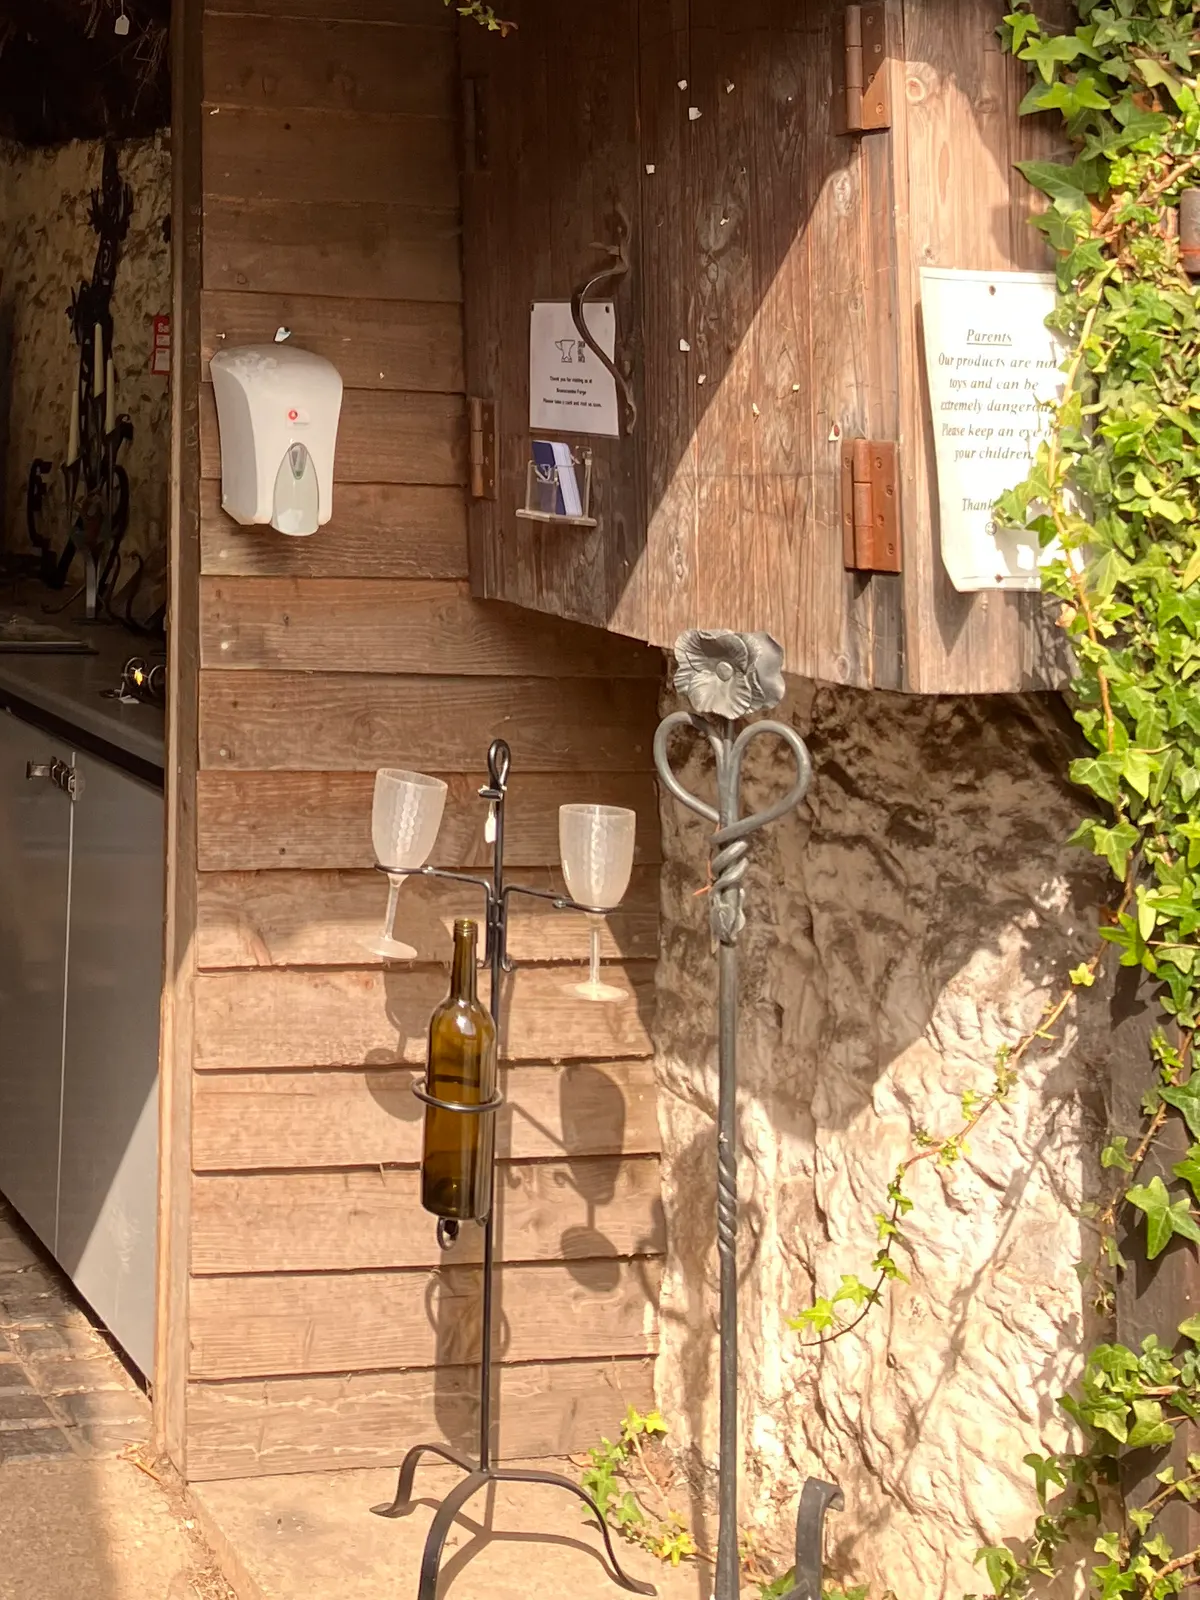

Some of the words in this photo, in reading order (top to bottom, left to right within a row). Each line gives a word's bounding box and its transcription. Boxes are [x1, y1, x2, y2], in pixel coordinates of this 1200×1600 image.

[966, 329, 1012, 343] Parents
[938, 352, 954, 366] Our
[956, 353, 1005, 369] products
[1010, 359, 1031, 368] are
[1036, 357, 1057, 369] not
[949, 377, 967, 392] toys
[970, 377, 992, 389] and
[996, 381, 1019, 390] can
[1023, 378, 1039, 391] be
[987, 399, 1050, 415] dangerou
[942, 423, 965, 437] Please
[968, 424, 994, 440] keep
[998, 428, 1014, 437] an
[1019, 428, 1039, 441] eye
[954, 449, 976, 462] your
